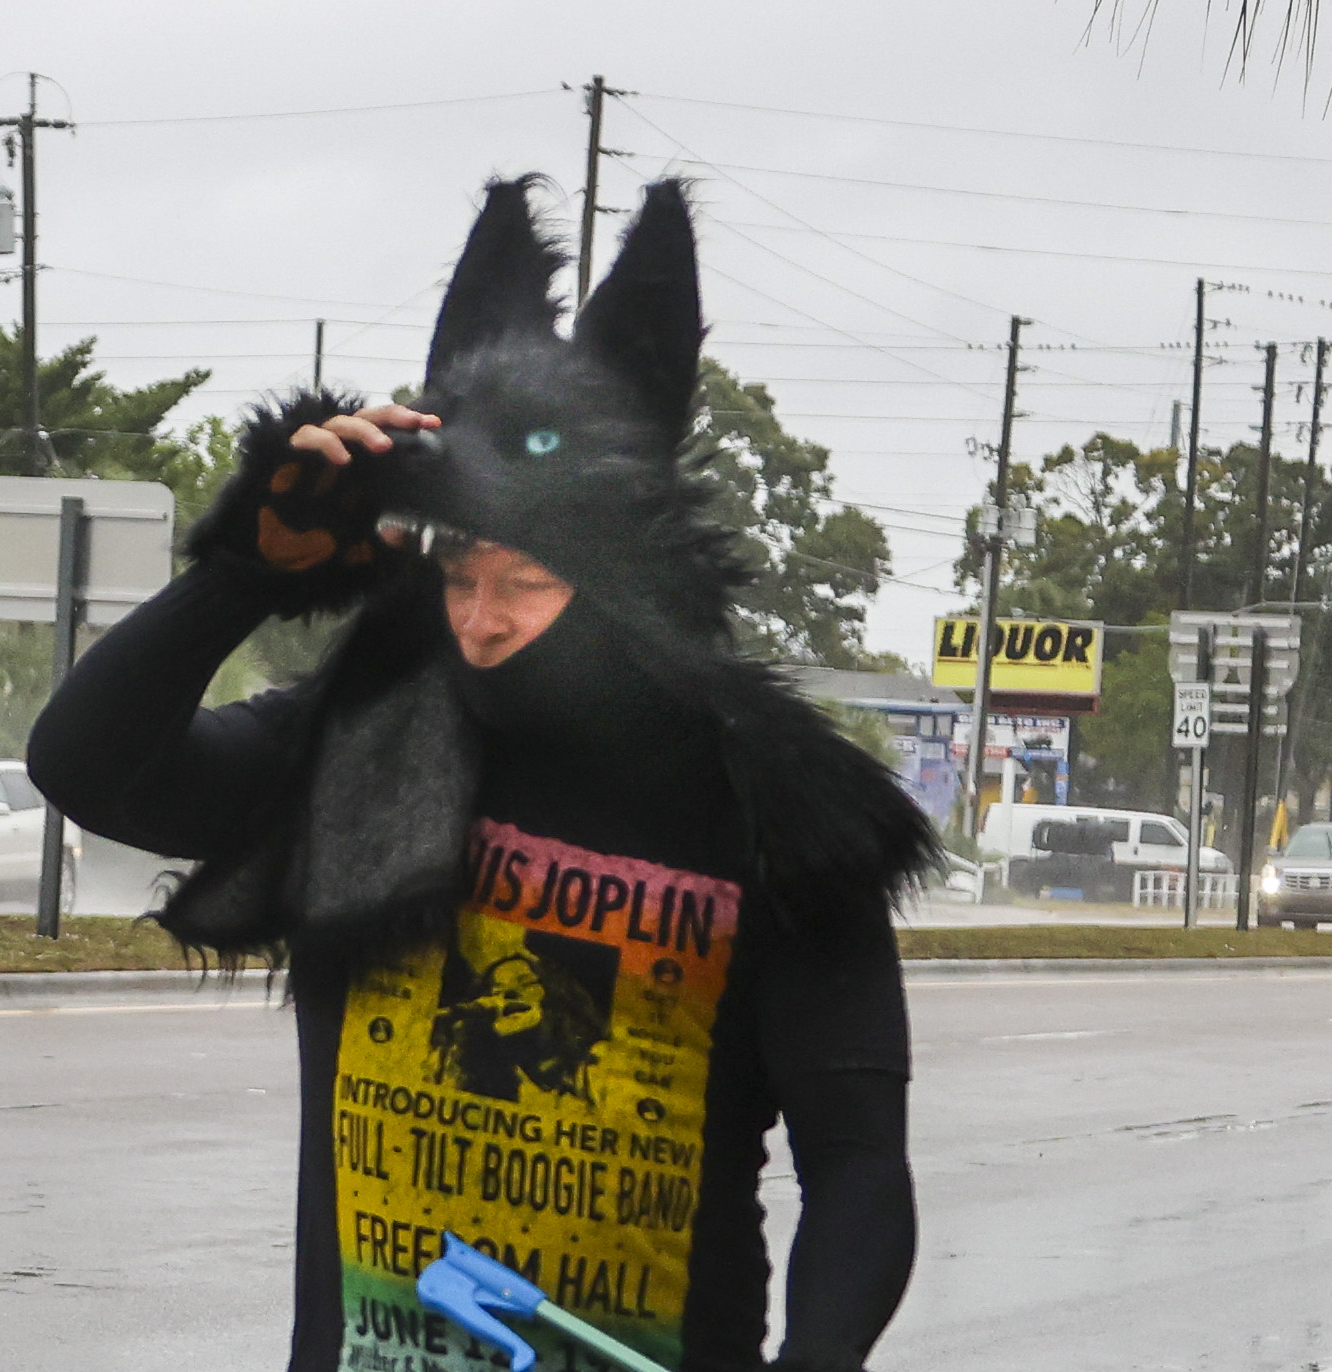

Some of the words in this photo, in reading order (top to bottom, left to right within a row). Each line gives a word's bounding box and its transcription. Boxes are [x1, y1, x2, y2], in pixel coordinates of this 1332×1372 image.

[1177, 716, 1207, 738] 40
[1178, 689, 1207, 699] SPEED
[1180, 702, 1203, 712] LIMIT
[526, 861, 716, 958] JOPLIN
[340, 1074, 543, 1142] INTRODUCING
[555, 1119, 618, 1155] HER
[629, 1132, 696, 1168] NEW
[483, 1141, 608, 1221] BOOGIE
[617, 1166, 691, 1232] BAND
[355, 1210, 543, 1286] FREEM
[557, 1252, 658, 1319] HALL
[356, 1296, 448, 1355] JUNE
